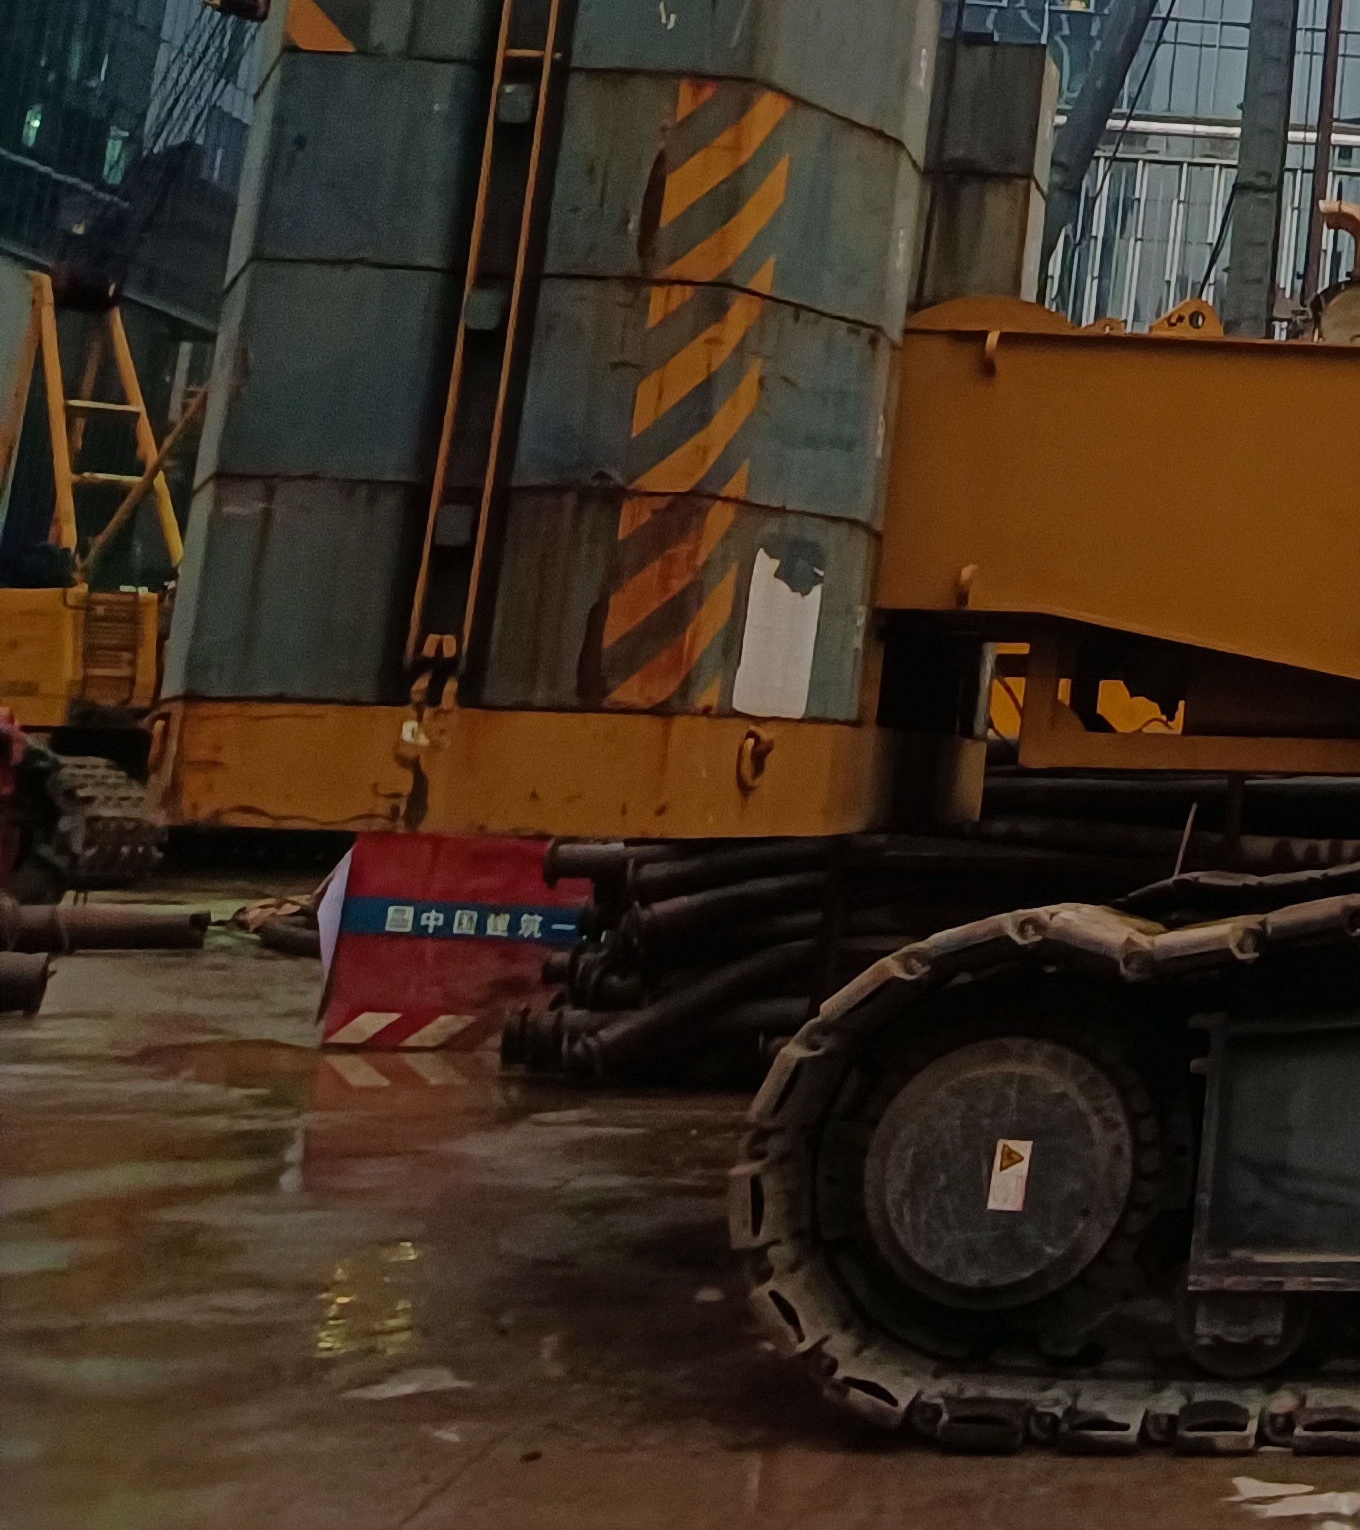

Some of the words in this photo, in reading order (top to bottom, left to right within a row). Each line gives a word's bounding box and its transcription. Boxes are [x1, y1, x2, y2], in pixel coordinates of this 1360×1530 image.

[420, 908, 606, 942] 中国建筑一
